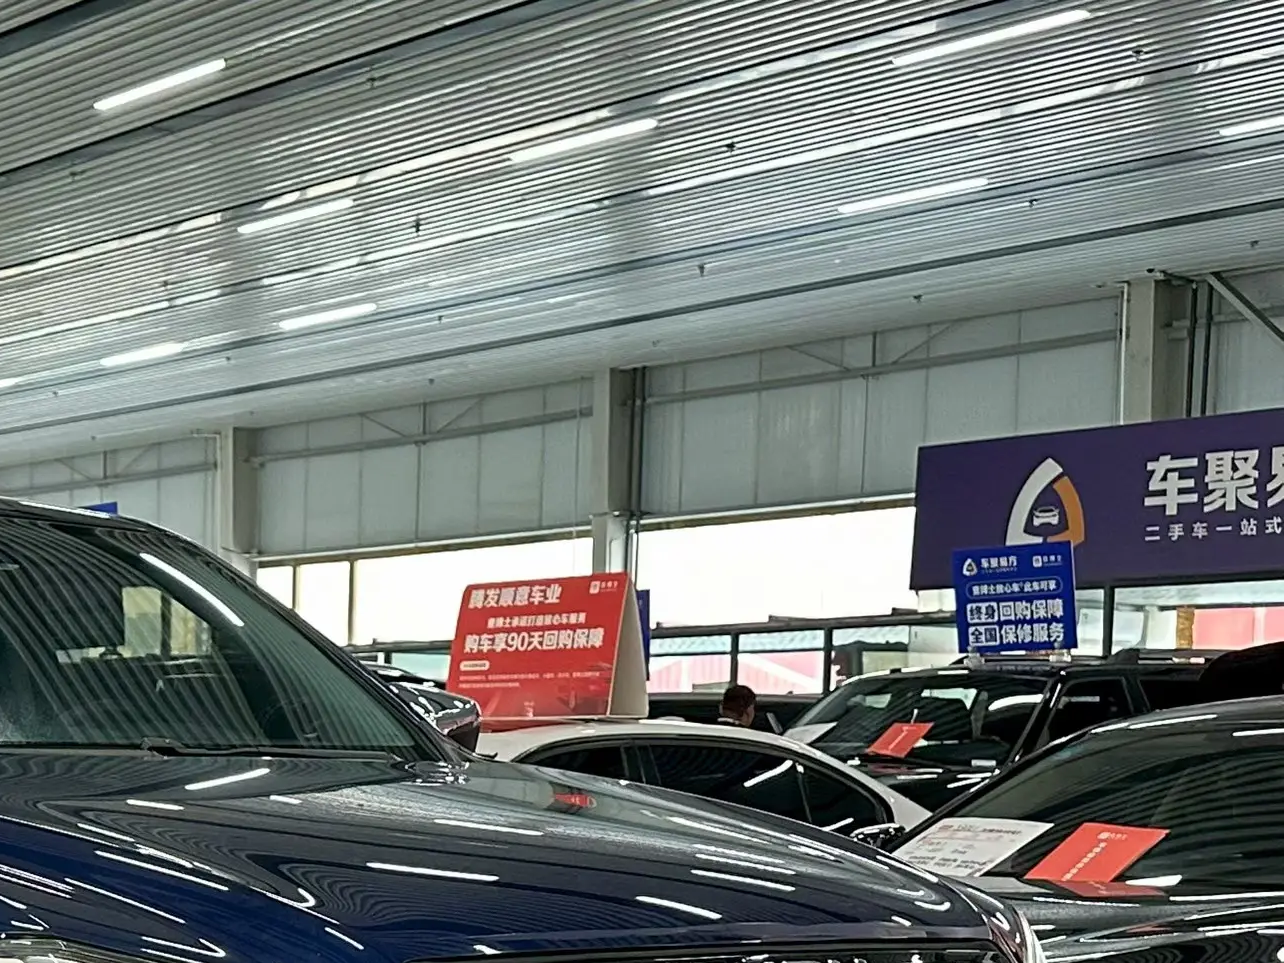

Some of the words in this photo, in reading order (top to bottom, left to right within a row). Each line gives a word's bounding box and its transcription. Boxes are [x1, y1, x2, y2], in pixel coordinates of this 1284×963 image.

[1145, 516, 1283, 541] 二手车一站式
[464, 628, 604, 653] 购车享90天回购保障
